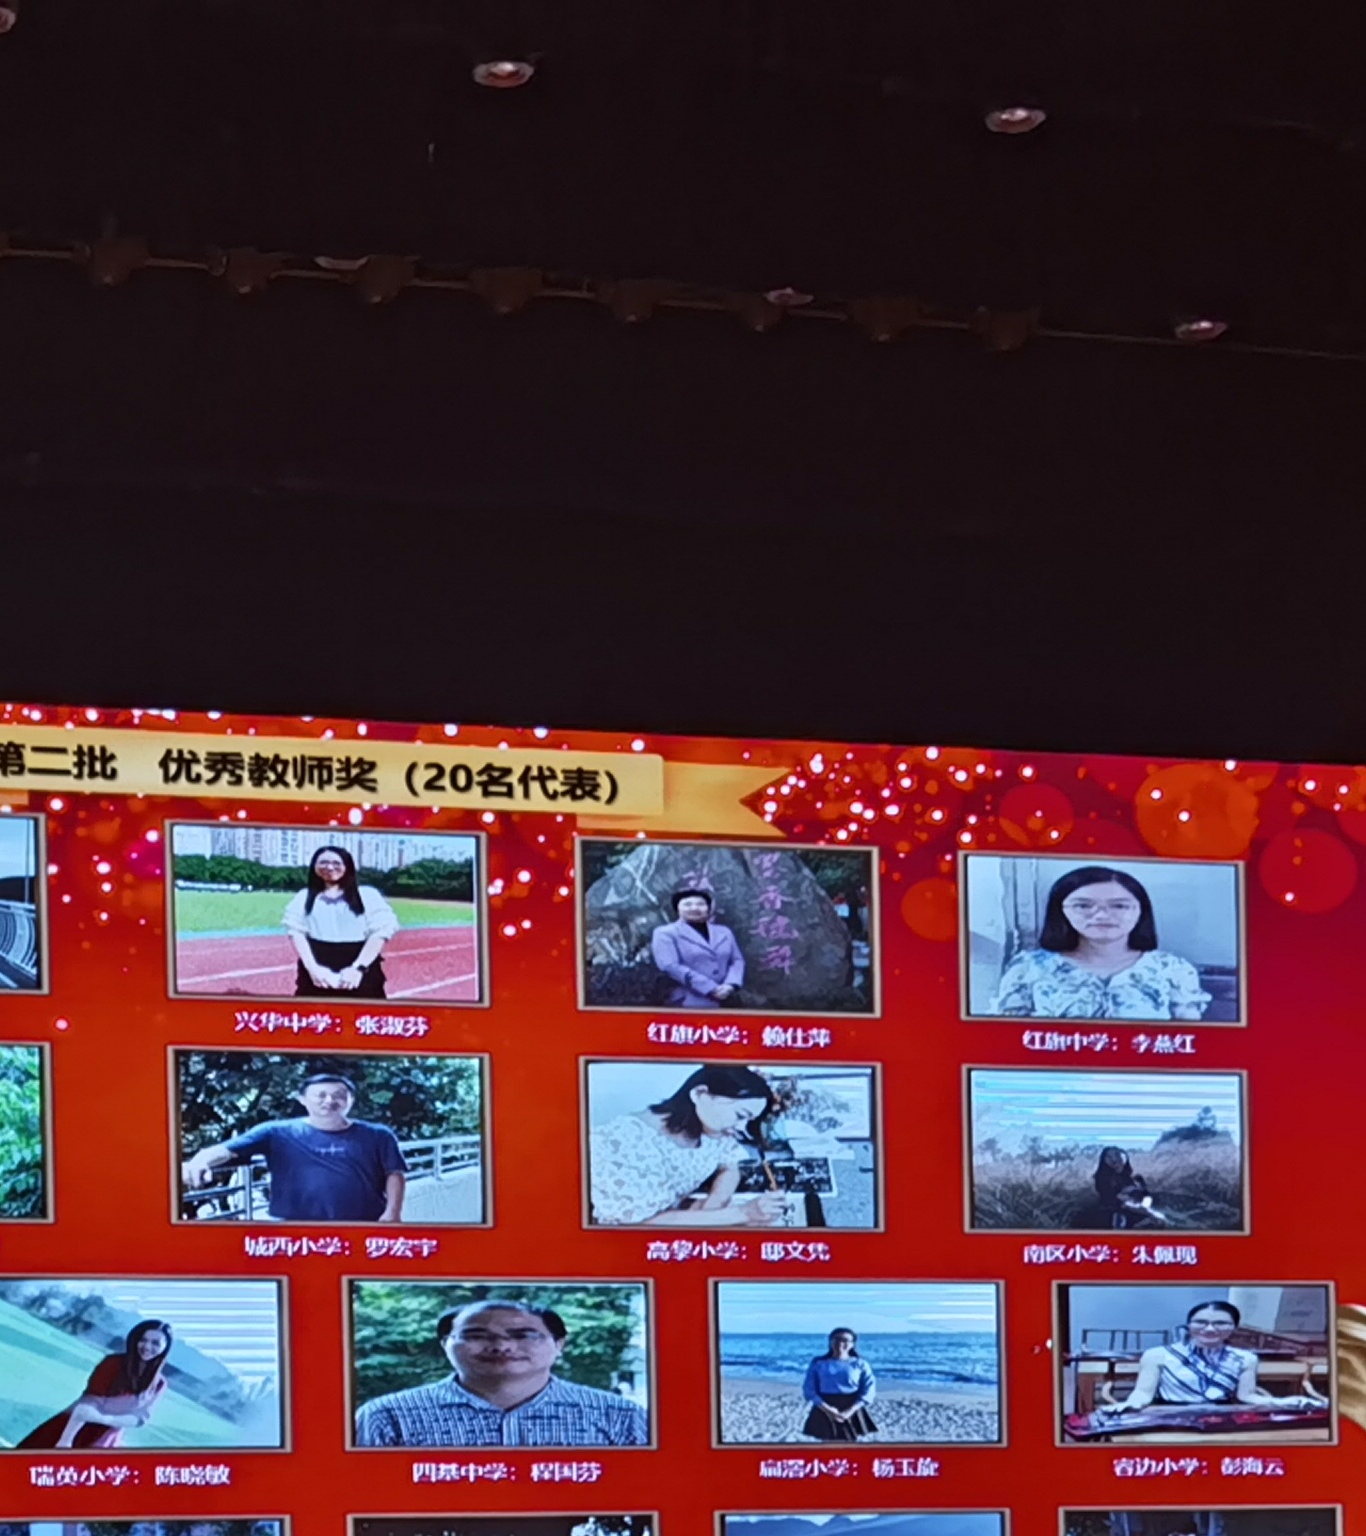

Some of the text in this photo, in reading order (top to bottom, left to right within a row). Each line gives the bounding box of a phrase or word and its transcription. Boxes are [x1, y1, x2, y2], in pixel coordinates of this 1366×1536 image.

[158, 747, 620, 804] 优秀教师奖（20名代表）
